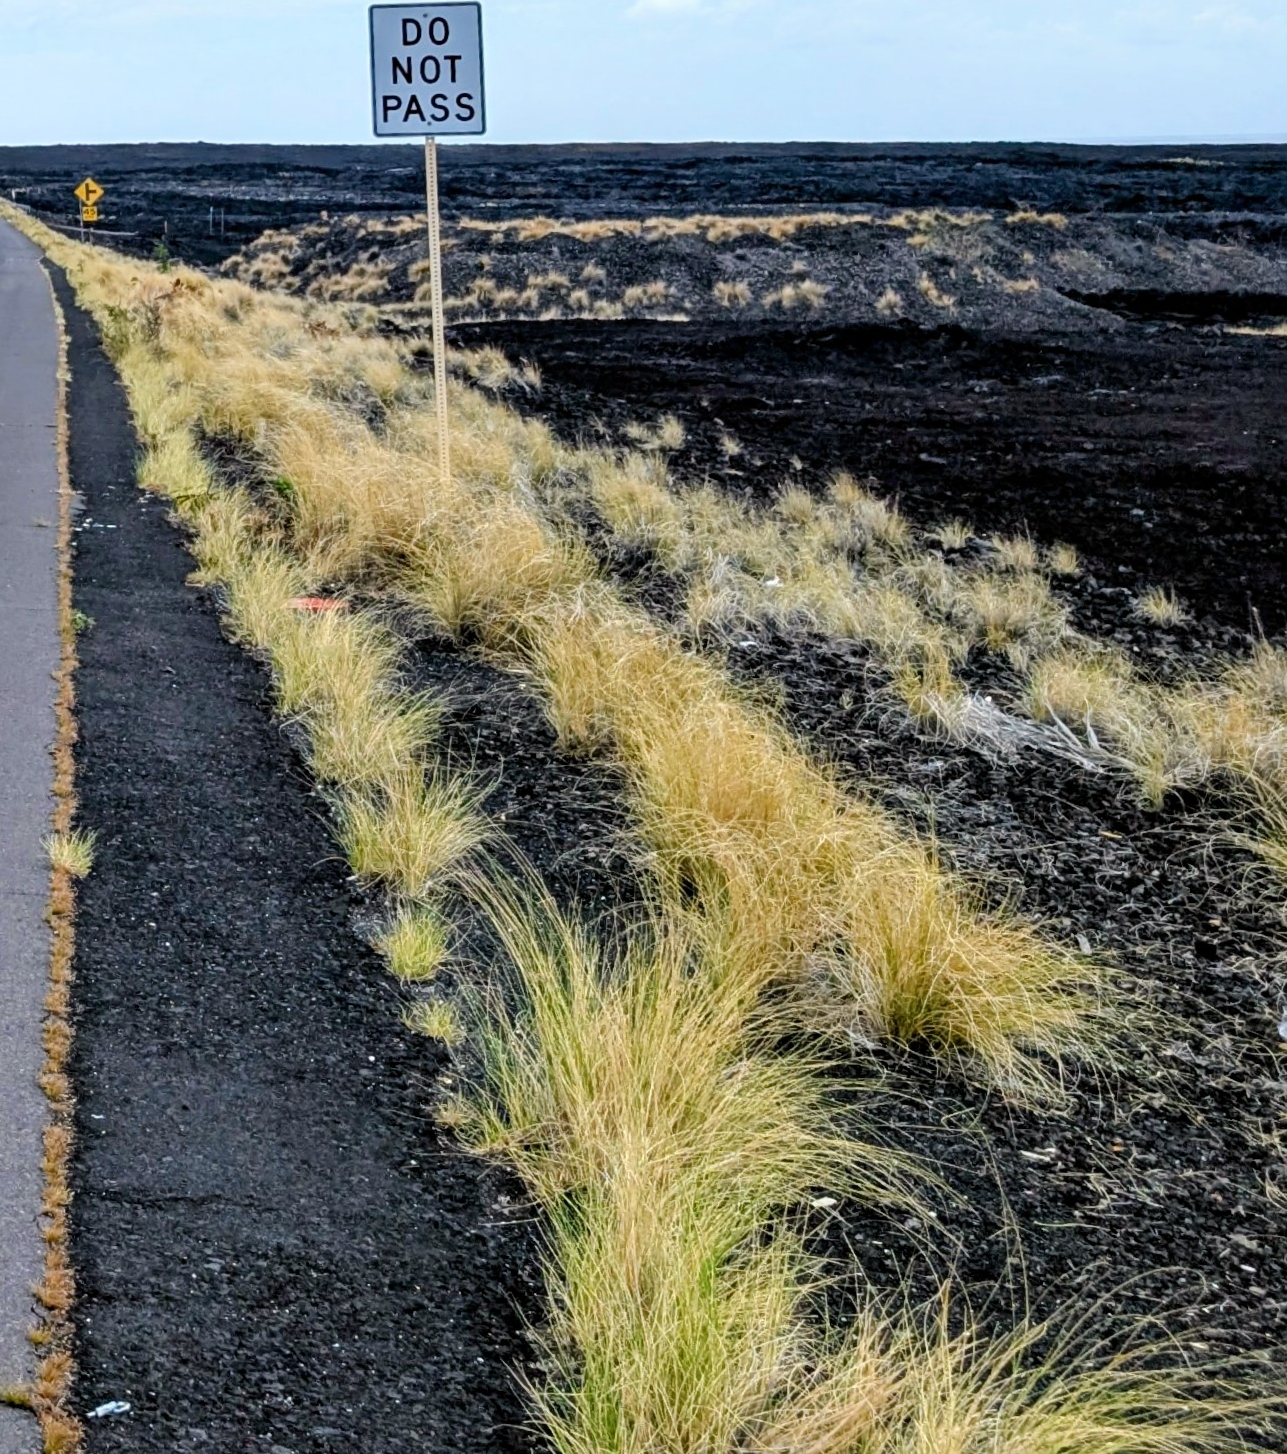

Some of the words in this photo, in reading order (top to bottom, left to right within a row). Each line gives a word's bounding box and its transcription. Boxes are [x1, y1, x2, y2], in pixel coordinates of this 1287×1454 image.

[402, 17, 450, 46] DO
[391, 55, 462, 84] NOT
[382, 92, 475, 123] PASS
